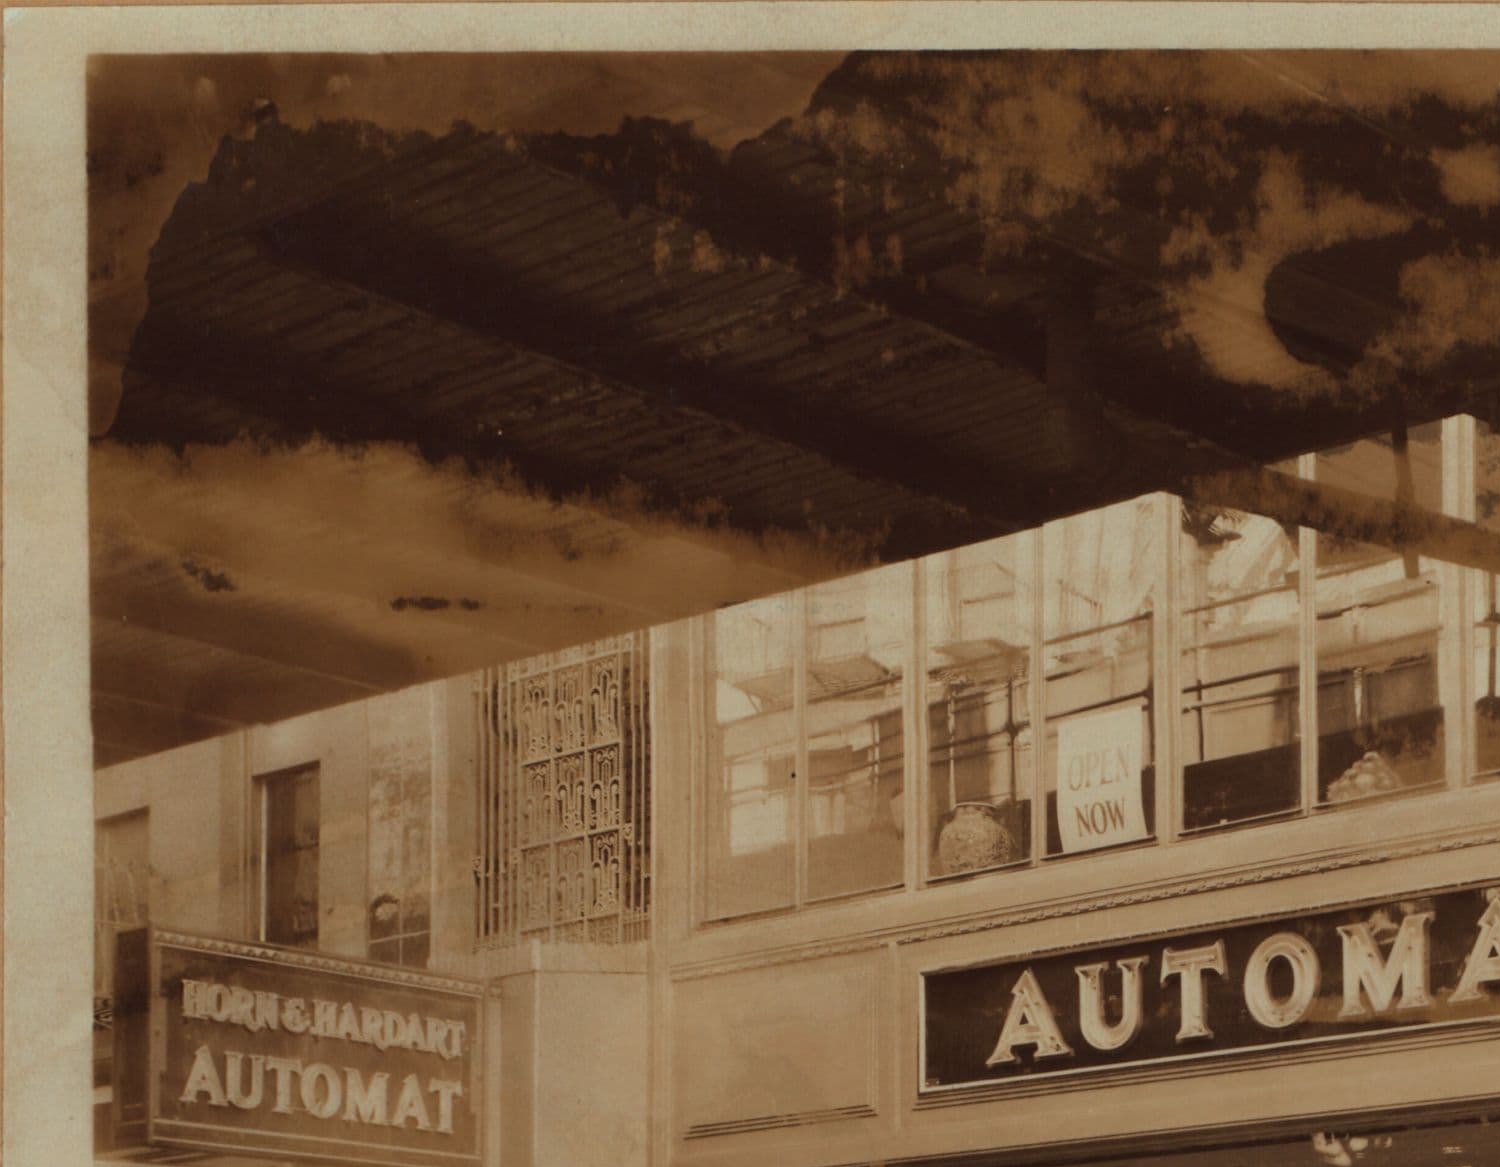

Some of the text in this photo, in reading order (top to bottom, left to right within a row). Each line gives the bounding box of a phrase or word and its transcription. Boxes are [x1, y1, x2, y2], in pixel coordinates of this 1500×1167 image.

[1068, 743, 1130, 791] OPEN
[1074, 796, 1126, 838] NOW
[179, 1044, 463, 1135] AUTOMAT
